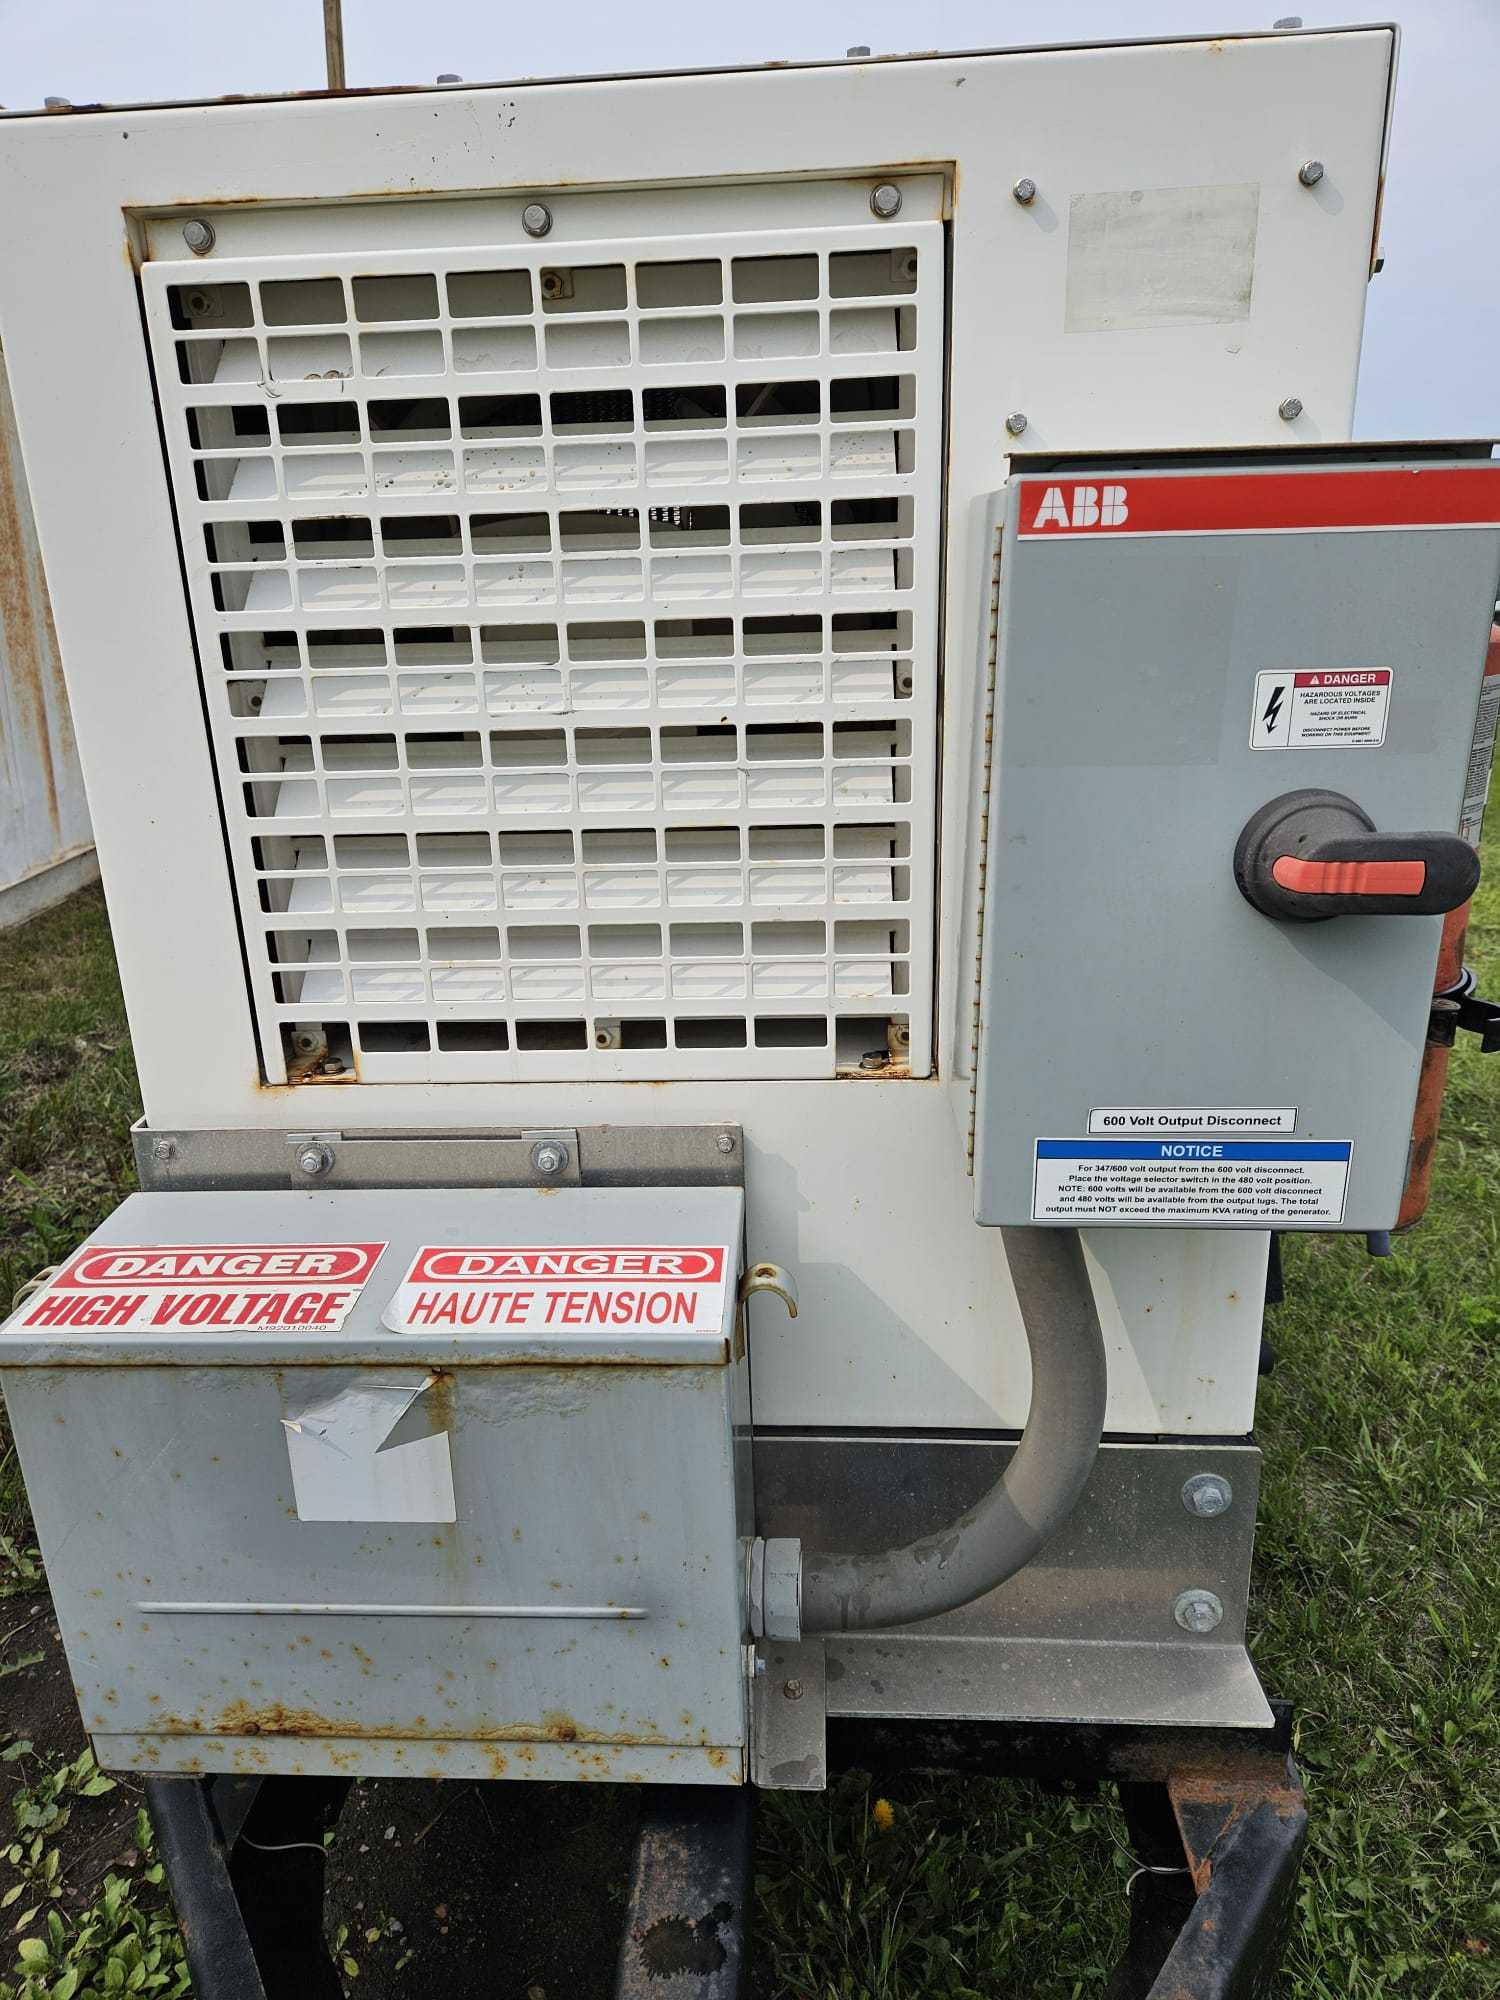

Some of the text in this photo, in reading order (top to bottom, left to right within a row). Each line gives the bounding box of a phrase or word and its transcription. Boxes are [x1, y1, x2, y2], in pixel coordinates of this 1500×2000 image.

[1032, 486, 1128, 528] ABB
[1324, 674, 1376, 684] DANGER
[1103, 1115, 1282, 1128] 600 Volt Output Disconnect
[1161, 1145, 1223, 1157] NOTICE
[1148, 1166, 1176, 1174] output
[1110, 1176, 1141, 1184] voltage
[1257, 1198, 1278, 1206] lugs.
[1046, 1206, 1072, 1214] output
[102, 1254, 338, 1277] DANGER
[457, 1255, 684, 1275] DANGER
[22, 1292, 351, 1326] HIGH VOLTAGE
[406, 1291, 698, 1324] HAUTE TENSION
